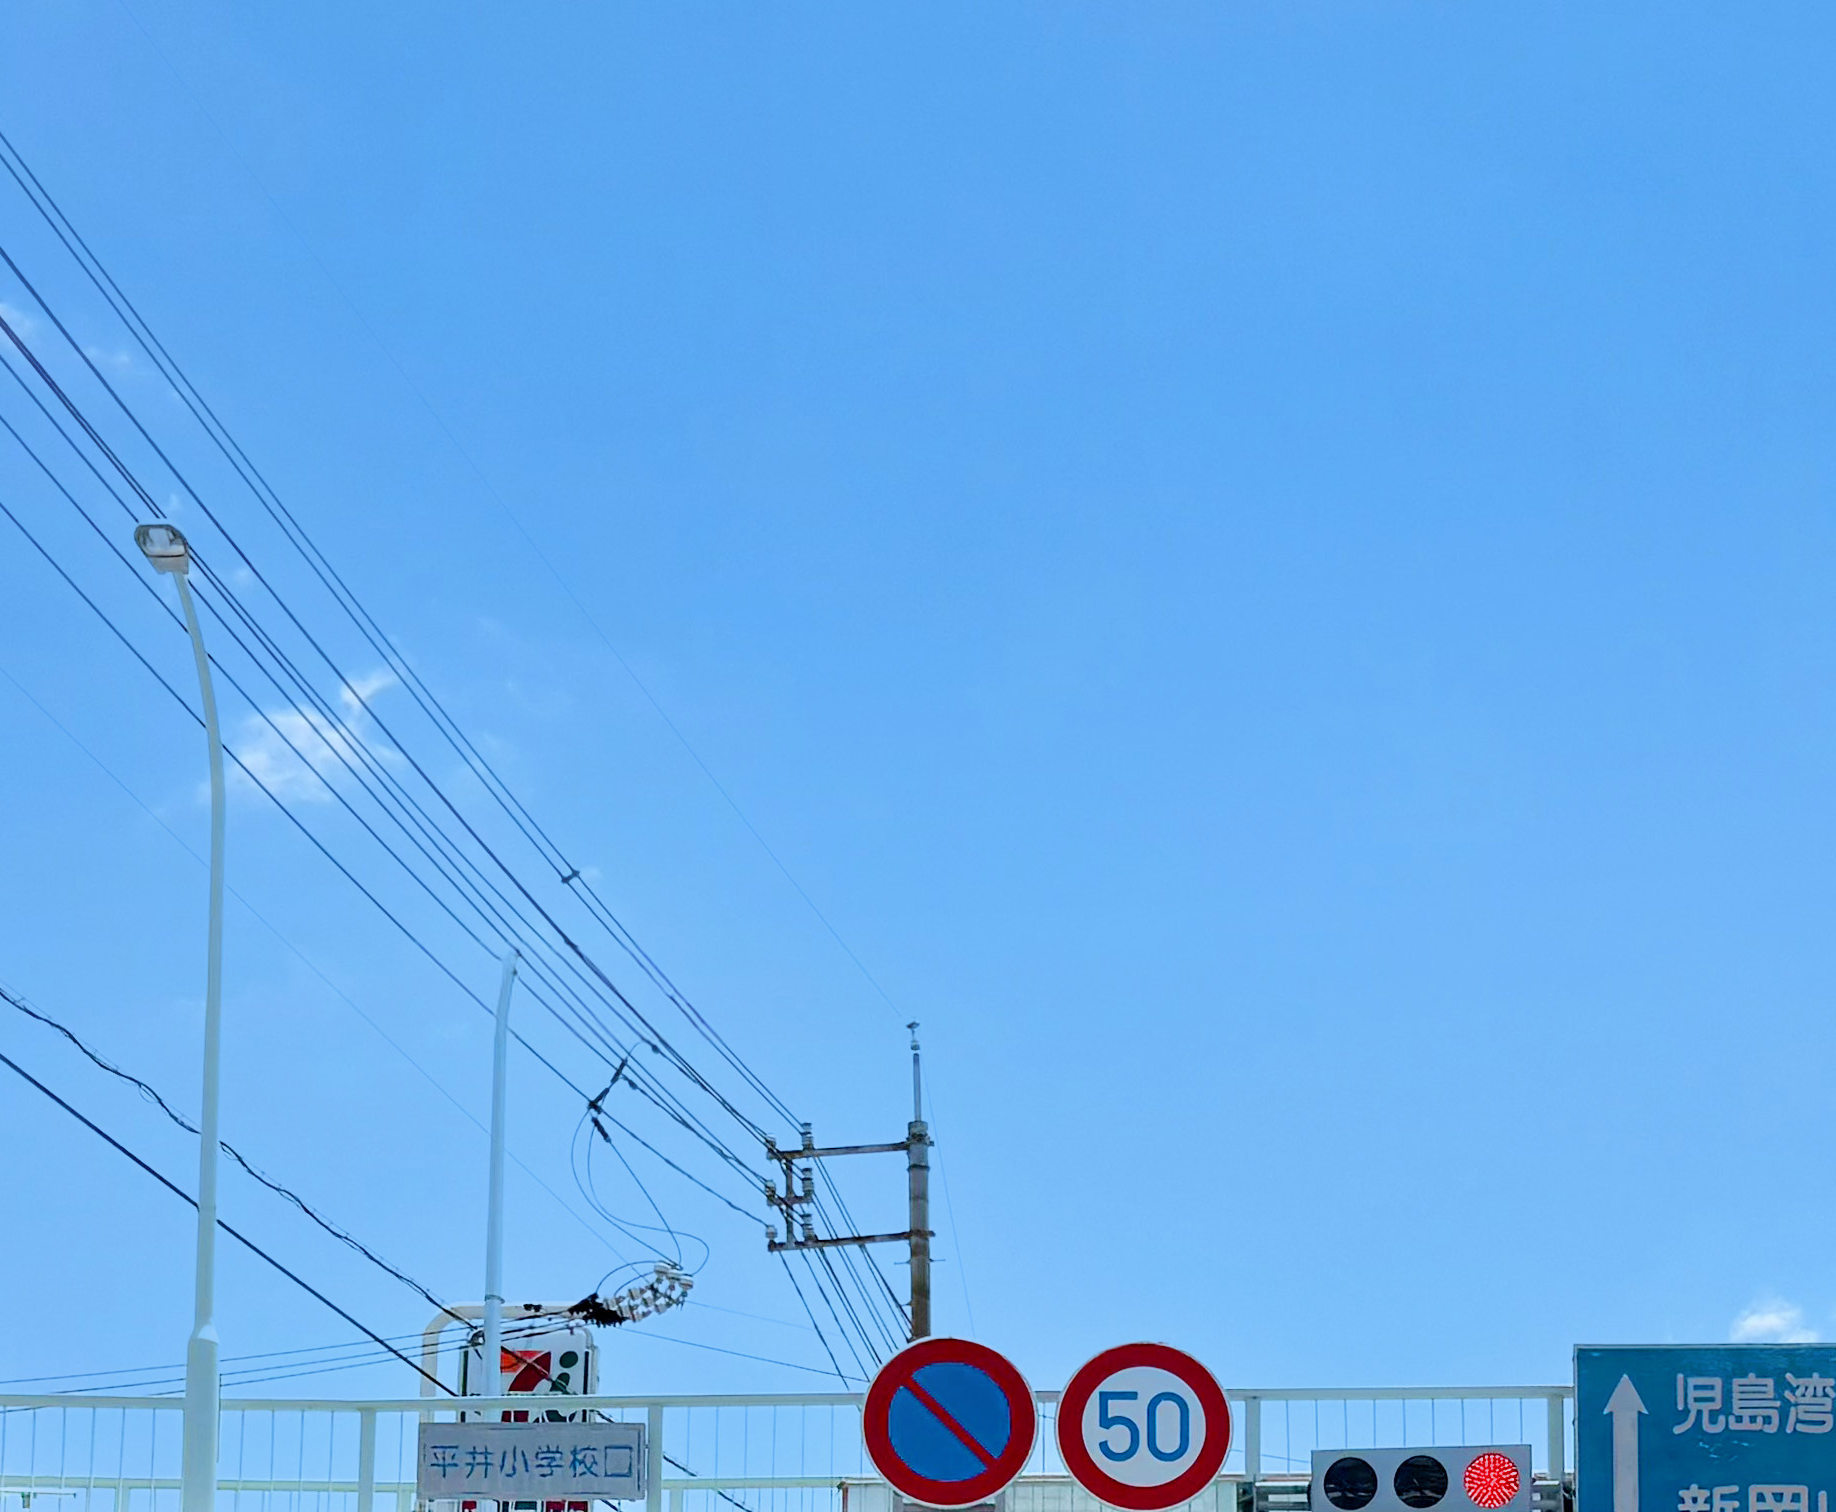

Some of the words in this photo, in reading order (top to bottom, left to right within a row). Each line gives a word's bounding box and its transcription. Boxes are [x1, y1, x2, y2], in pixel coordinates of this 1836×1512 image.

[1098, 1391, 1190, 1463] 50
[430, 1444, 633, 1479] 平井小学校口
